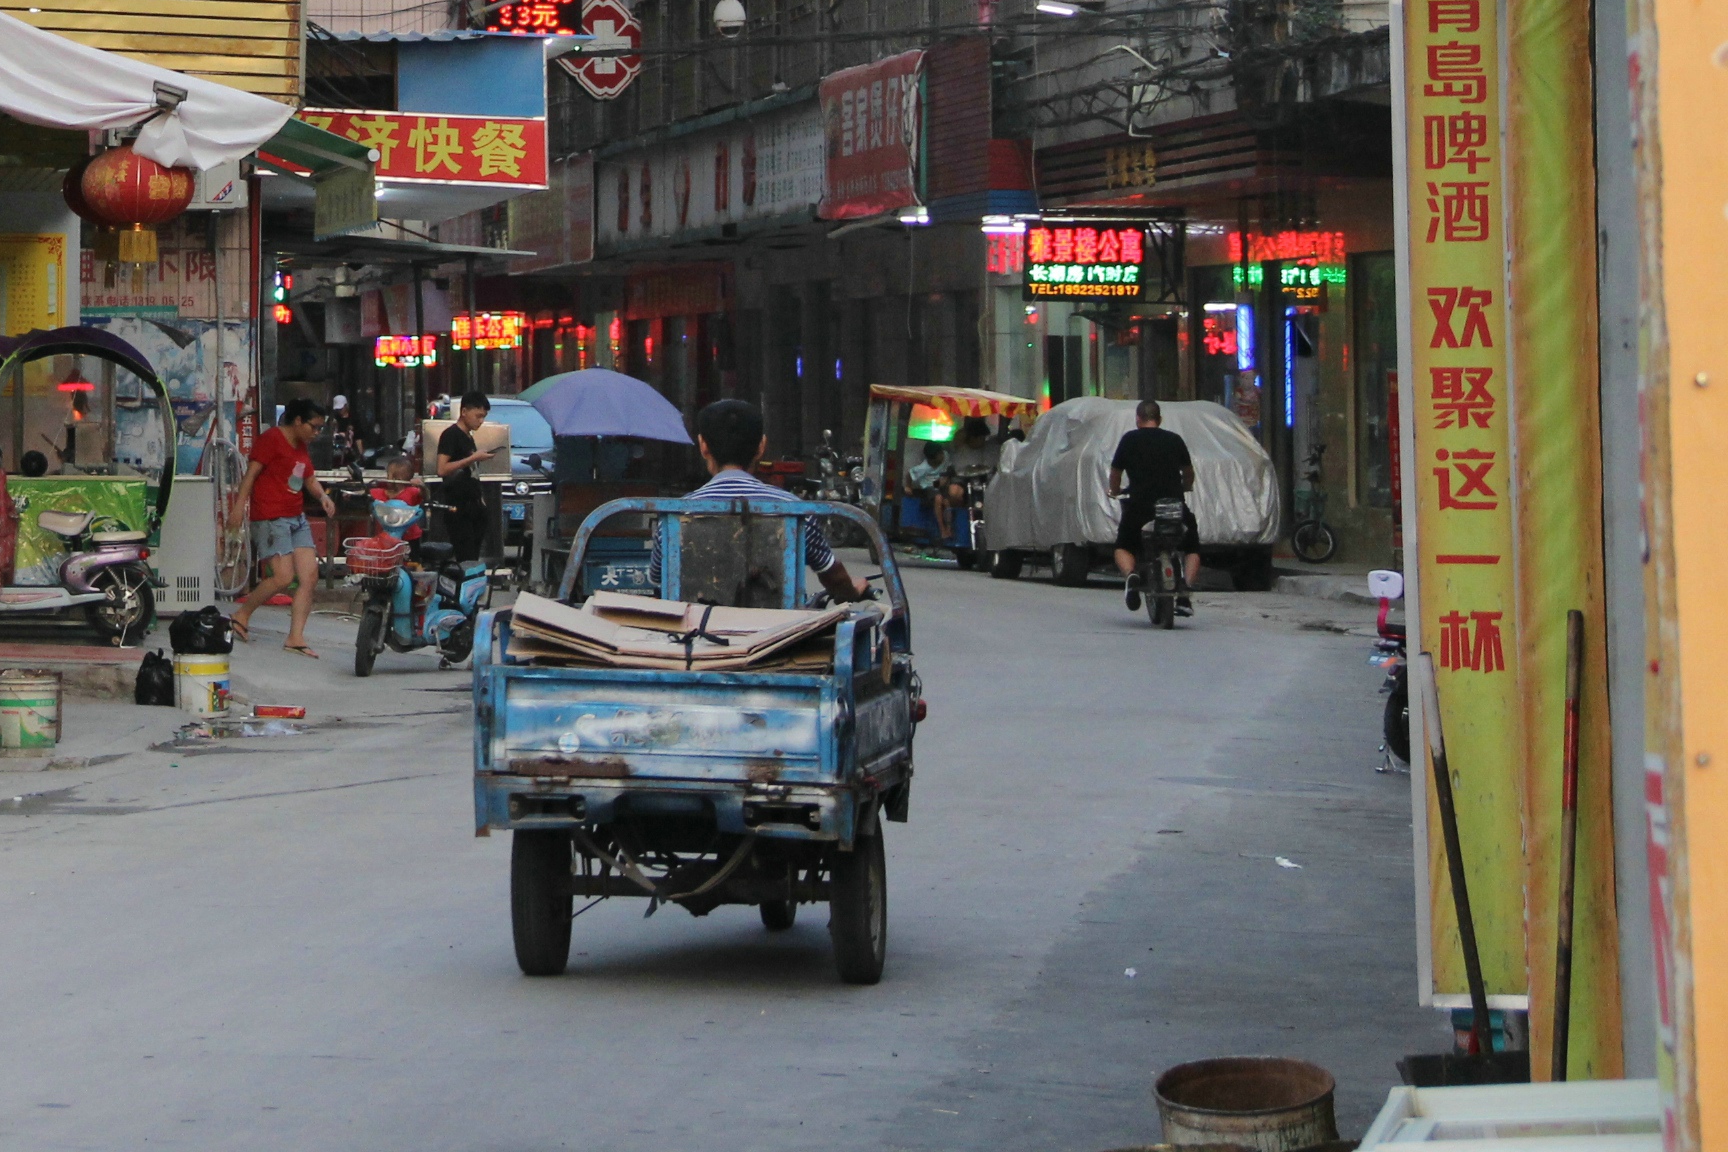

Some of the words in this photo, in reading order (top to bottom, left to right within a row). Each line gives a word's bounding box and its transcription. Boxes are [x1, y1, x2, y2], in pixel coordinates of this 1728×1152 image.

[295, 115, 526, 178] 济快餐
[1426, 286, 1506, 673] 欢聚这一杯
